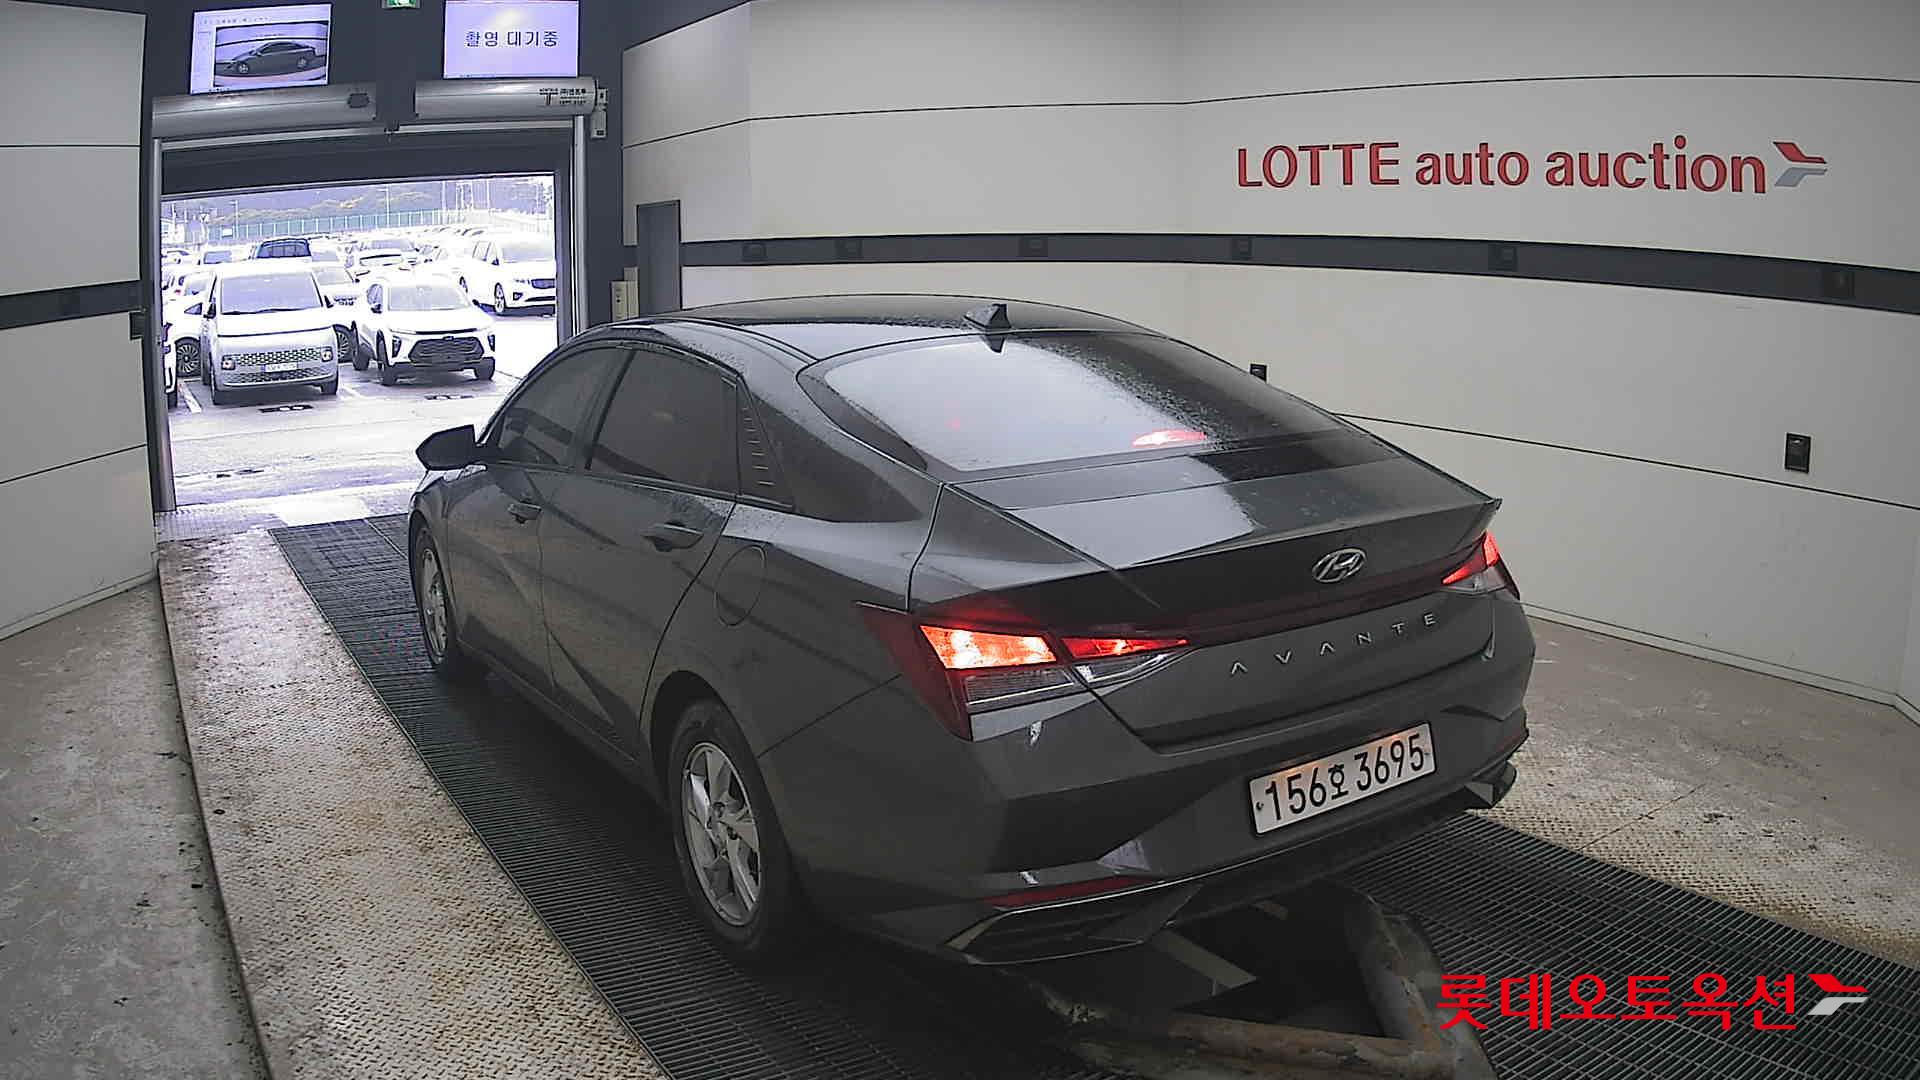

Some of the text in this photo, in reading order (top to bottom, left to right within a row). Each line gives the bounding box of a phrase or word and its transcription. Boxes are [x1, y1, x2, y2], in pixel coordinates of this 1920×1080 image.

[465, 31, 559, 47] 촬영 대기중
[1238, 135, 1766, 194] LOTTE auto auction
[1231, 613, 1436, 675] AVANTE
[1265, 735, 1425, 821] 156호 3695
